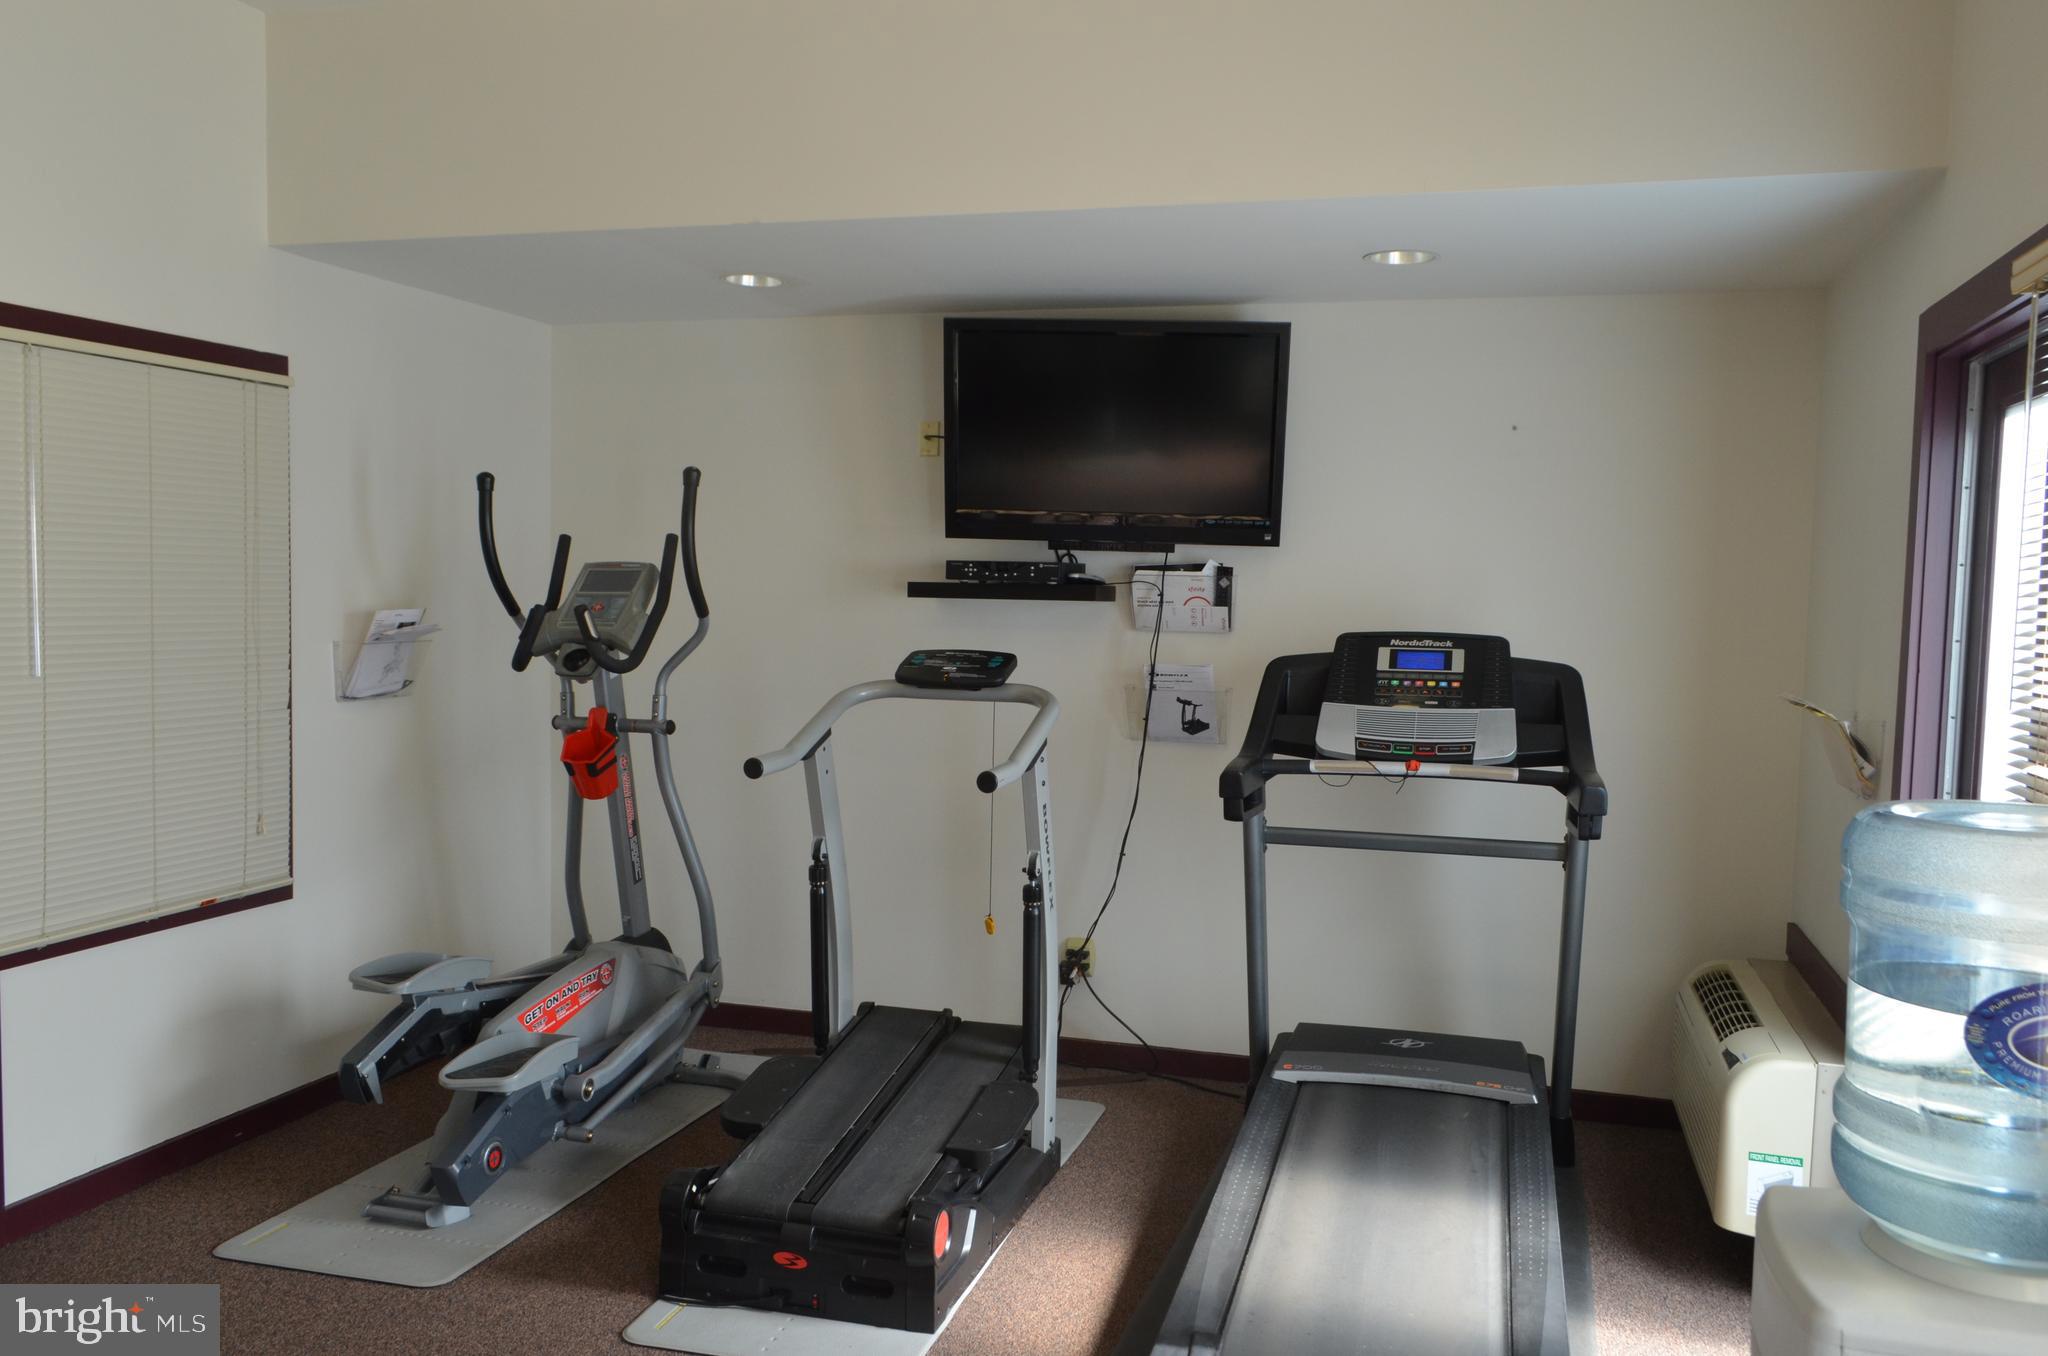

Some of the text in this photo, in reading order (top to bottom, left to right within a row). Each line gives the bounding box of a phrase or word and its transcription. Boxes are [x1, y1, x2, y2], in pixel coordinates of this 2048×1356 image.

[1389, 638, 1453, 647] NordicTrack
[1043, 803, 1053, 911] BOWFLEX
[524, 1003, 544, 1025] GET
[545, 991, 560, 1010] ON
[560, 980, 580, 1000] AND
[580, 969, 599, 987] TRY
[1988, 999, 2011, 1013] PURE
[2012, 991, 2036, 1002] FROM
[1992, 1041, 2042, 1080] PREMIUM
[1750, 1153, 1802, 1166] FRONT PANEL REMOVAL
